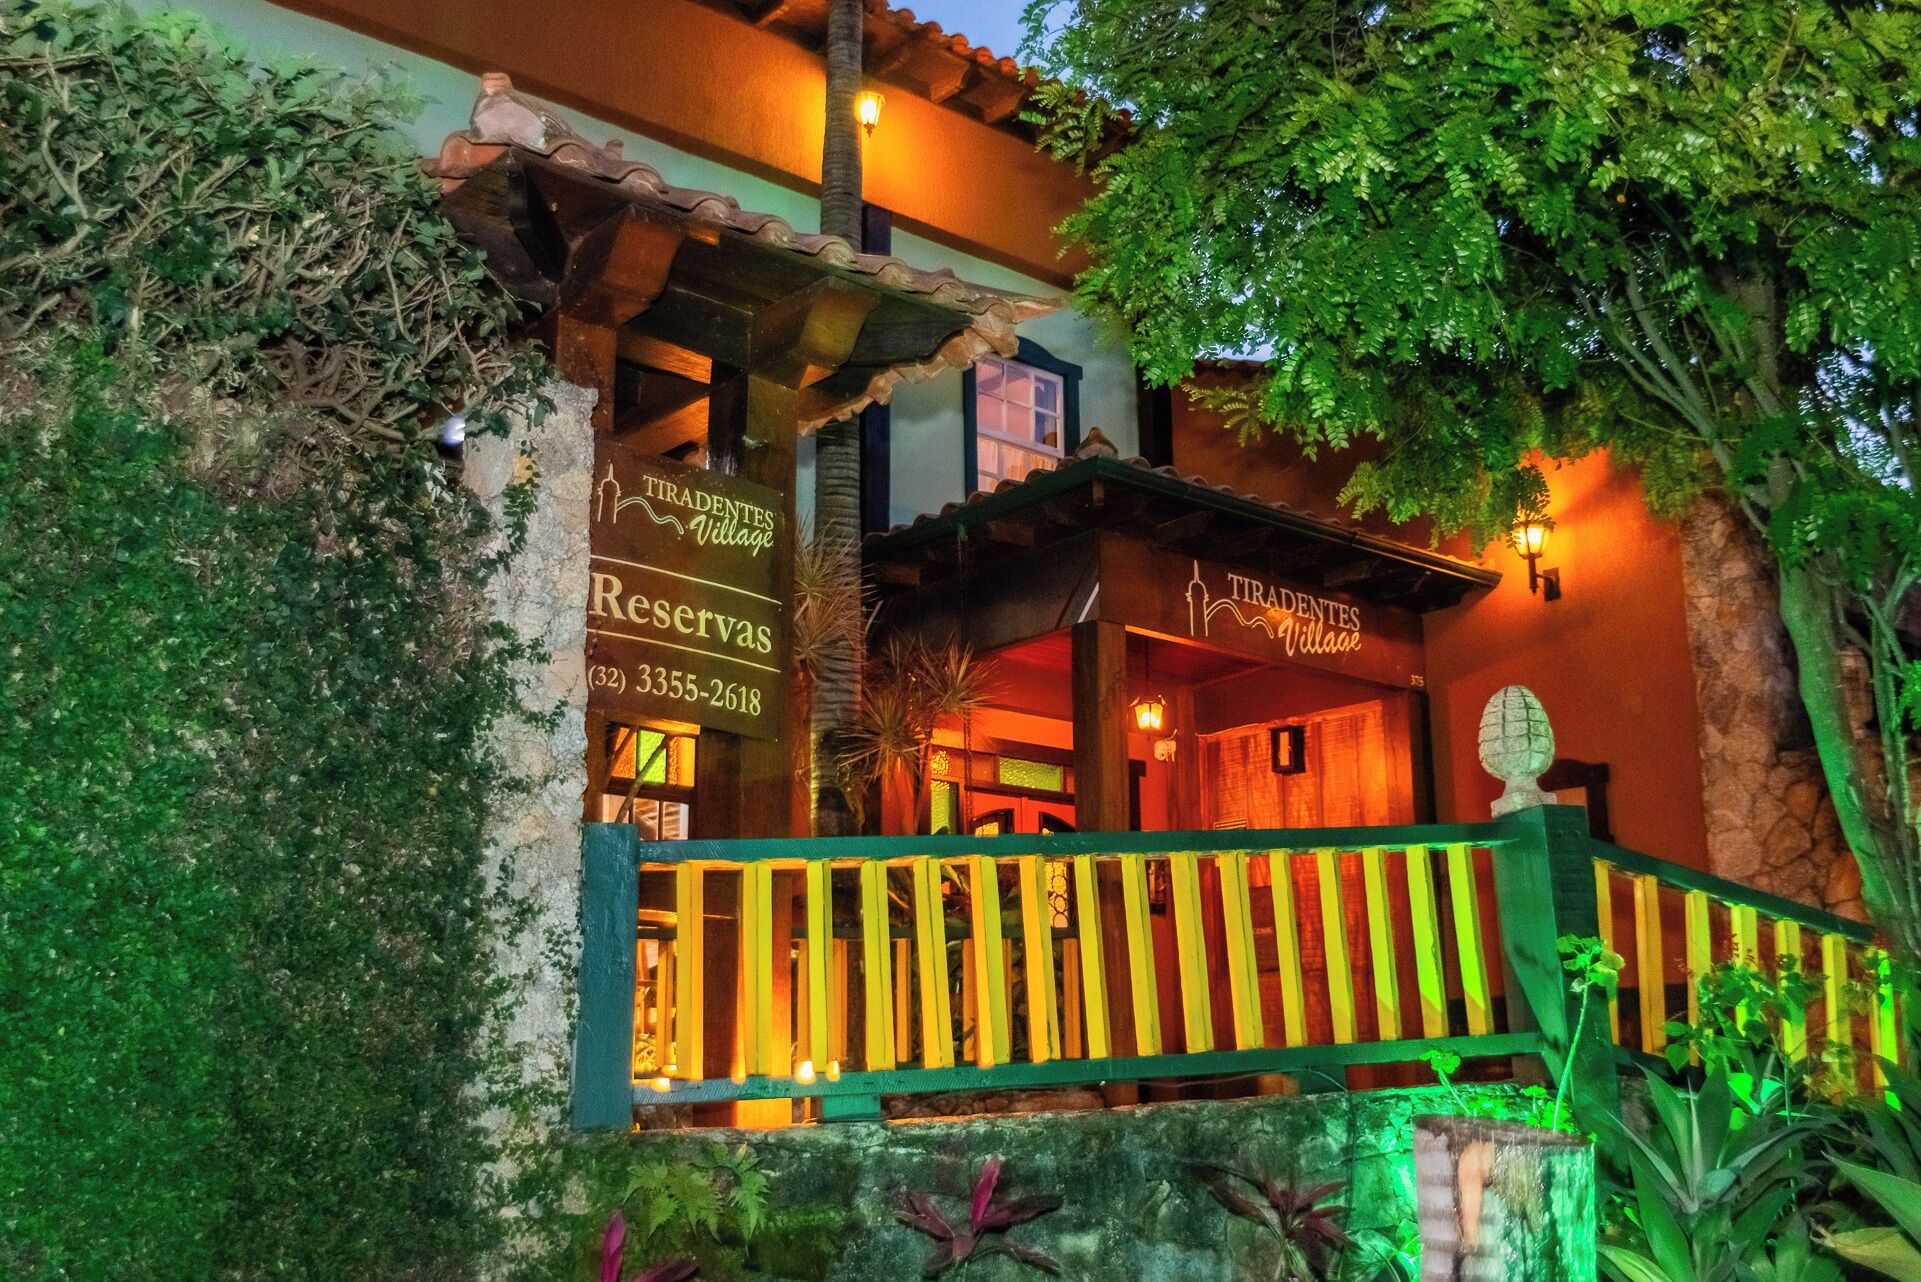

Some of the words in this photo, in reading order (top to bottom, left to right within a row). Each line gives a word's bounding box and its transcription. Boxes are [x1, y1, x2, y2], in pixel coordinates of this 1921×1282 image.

[643, 475, 774, 531] TIRADENTES
[689, 514, 775, 557] Village
[588, 572, 773, 653] Reservas
[1227, 573, 1361, 631] TIRADENTES
[1278, 617, 1362, 660] Village
[588, 665, 627, 694] (32)
[636, 664, 762, 716] 3355-2618
[1410, 674, 1425, 687] 375
